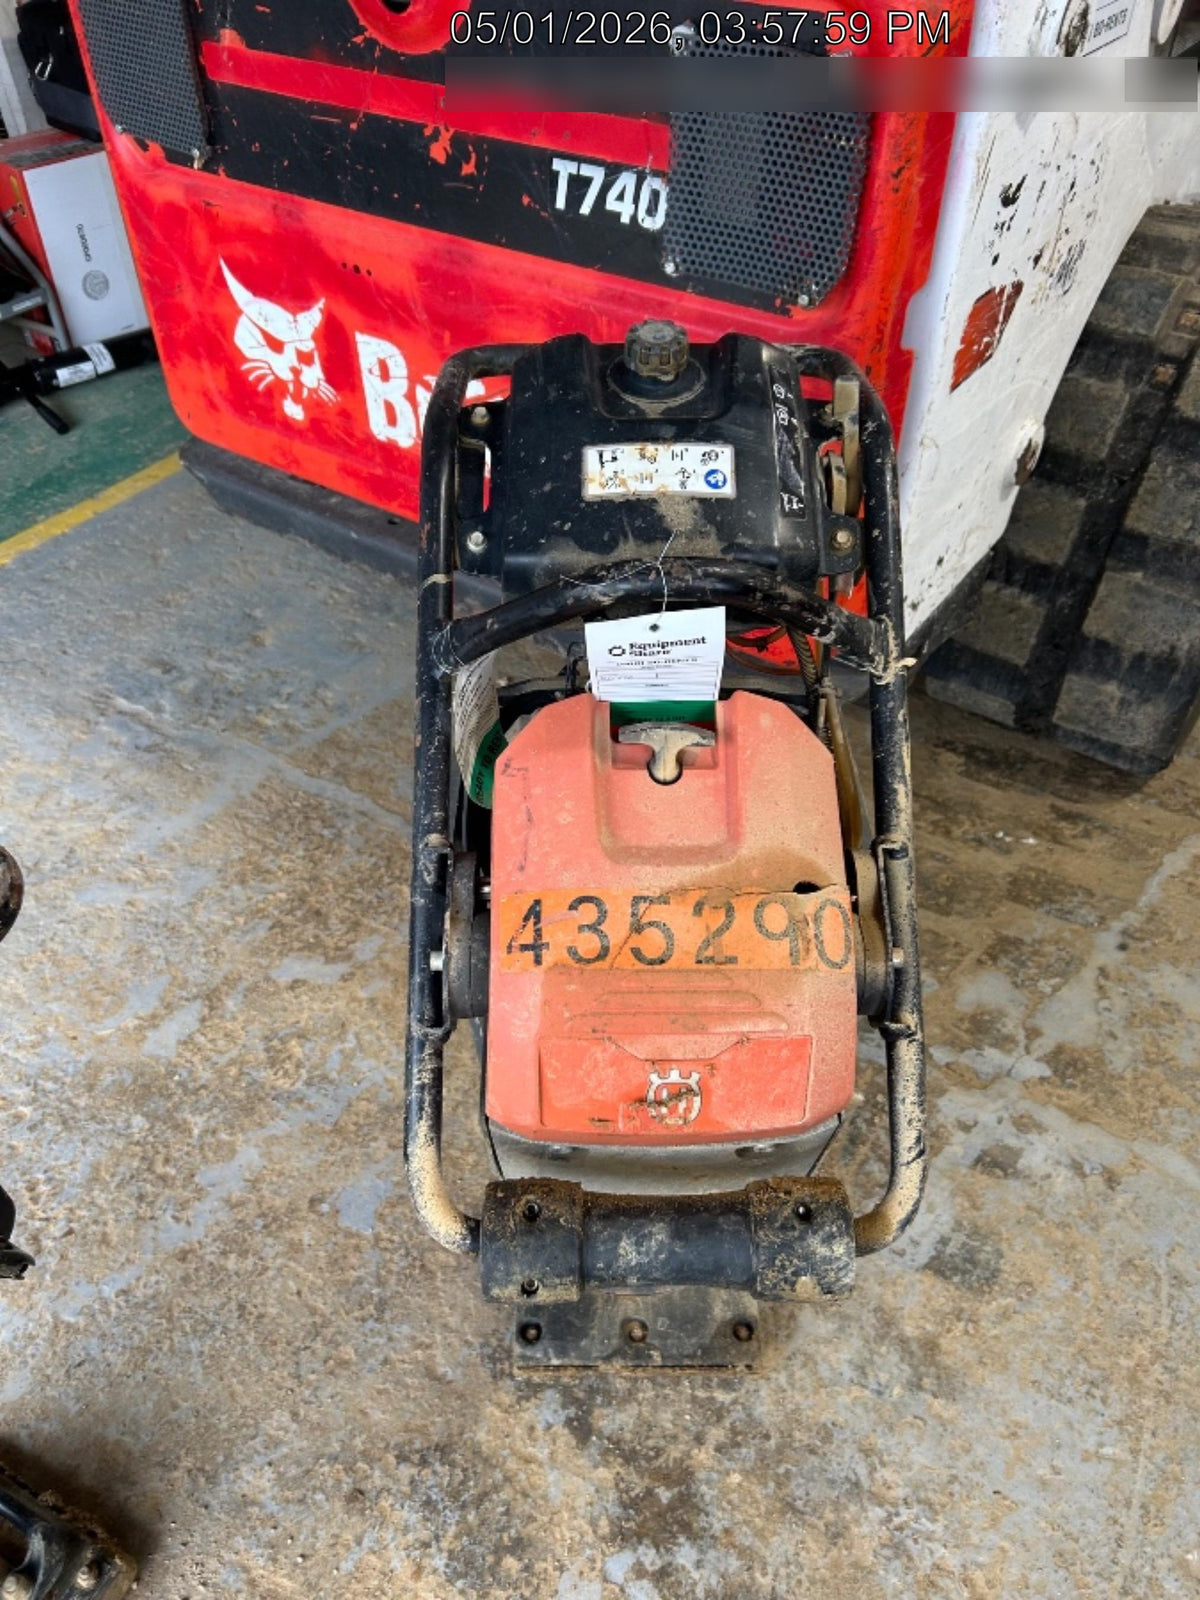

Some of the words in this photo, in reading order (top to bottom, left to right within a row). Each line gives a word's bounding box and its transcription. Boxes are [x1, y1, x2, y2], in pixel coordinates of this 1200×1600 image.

[551, 157, 669, 232] T740
[628, 636, 706, 651] Equipment
[506, 894, 852, 969] 435290
